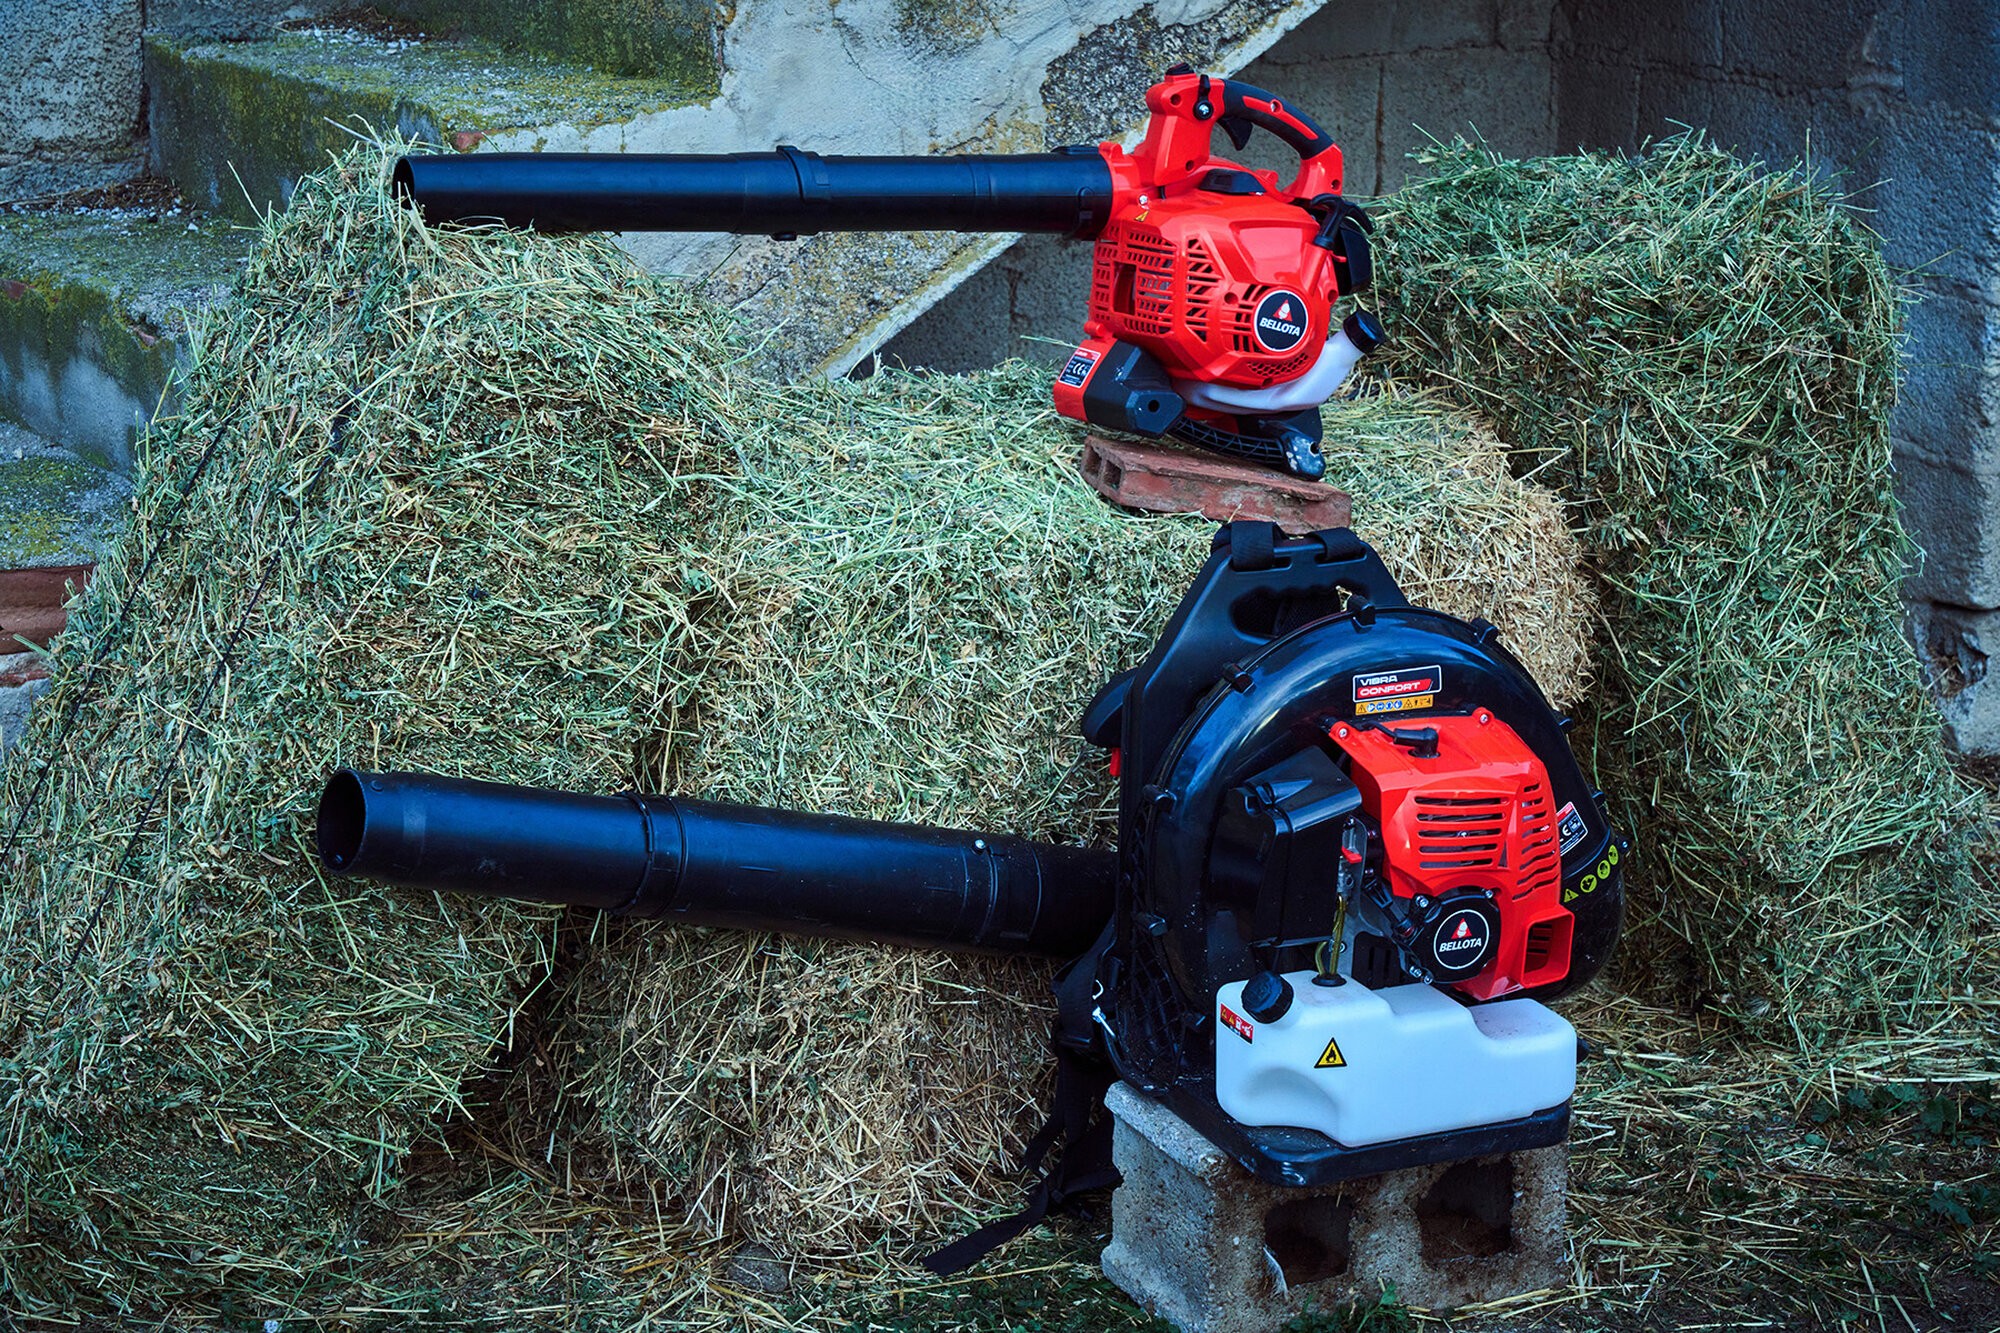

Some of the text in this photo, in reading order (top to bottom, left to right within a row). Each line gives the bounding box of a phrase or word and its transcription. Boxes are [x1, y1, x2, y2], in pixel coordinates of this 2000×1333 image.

[1259, 317, 1301, 337] BELLOTA
[1360, 675, 1398, 686] VIBRA
[1360, 682, 1420, 696] CONFORT
[1439, 937, 1482, 953] BELLOTA
